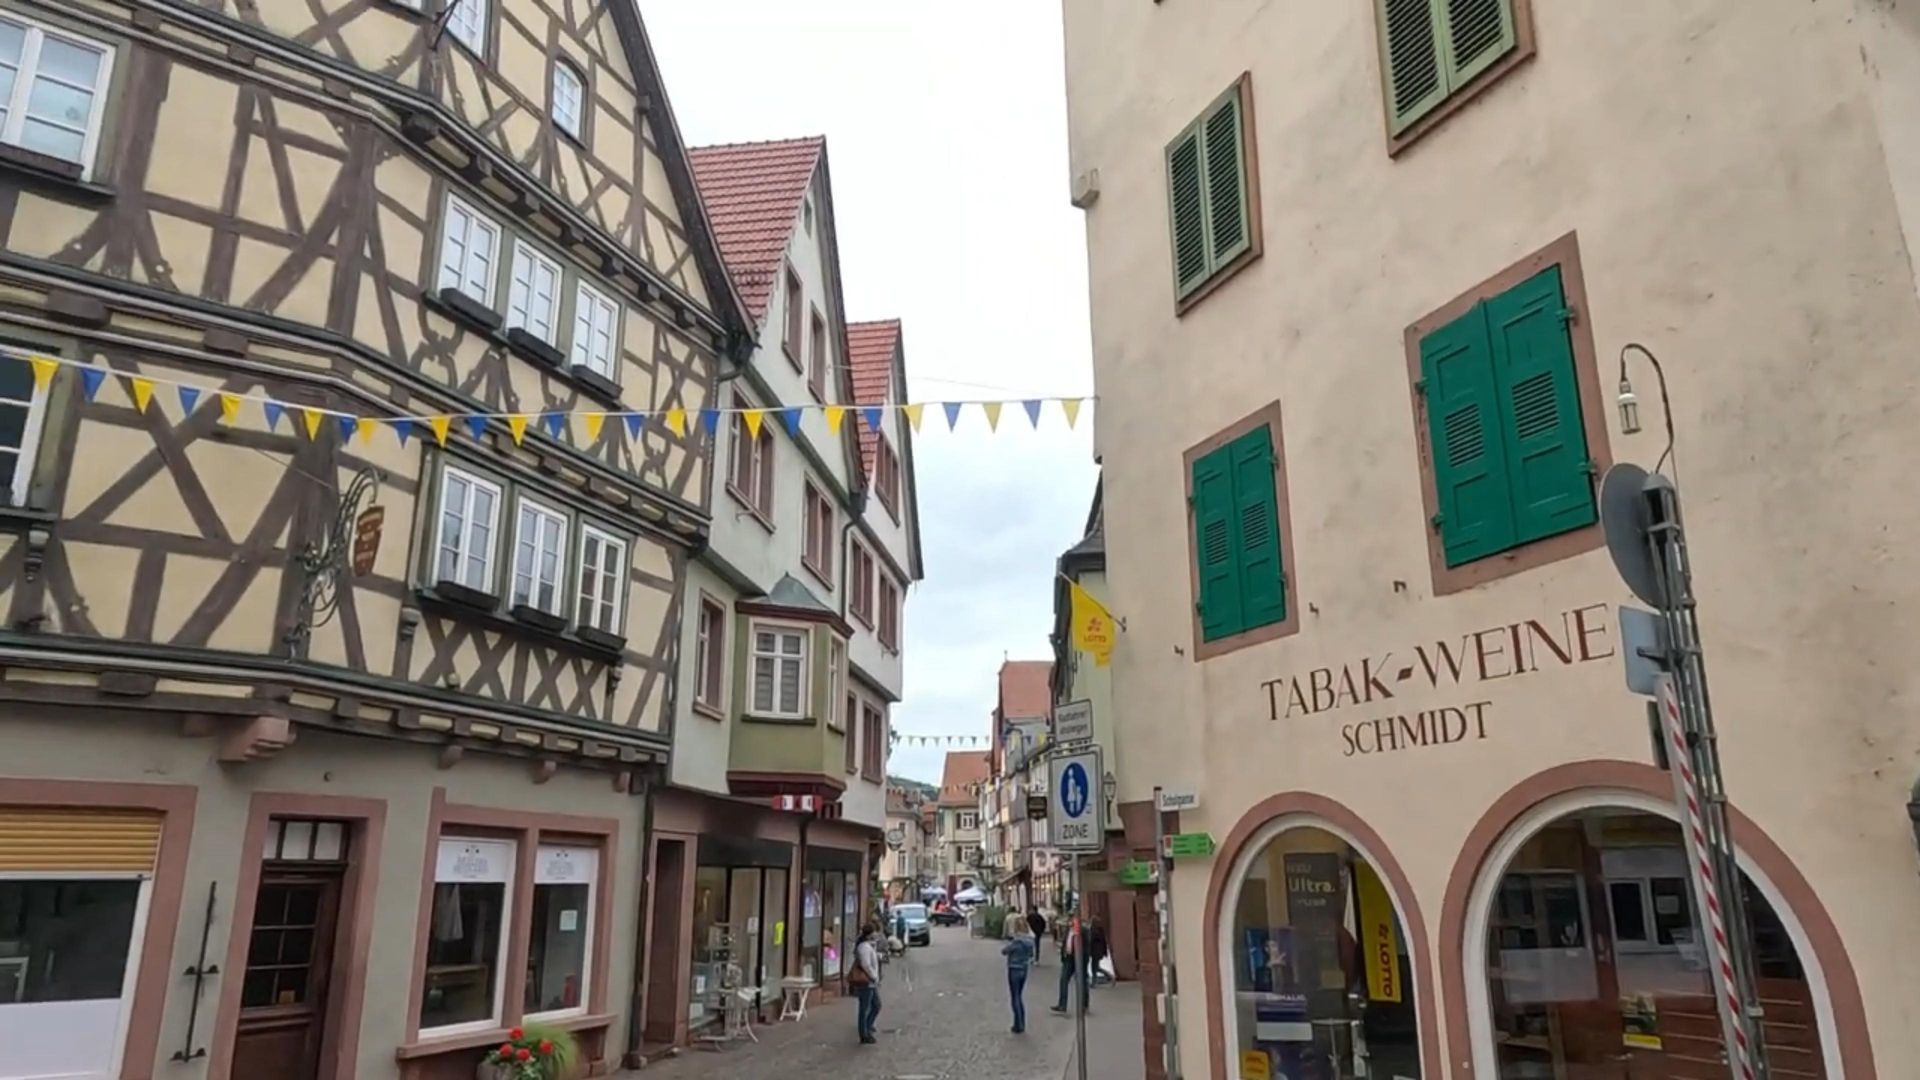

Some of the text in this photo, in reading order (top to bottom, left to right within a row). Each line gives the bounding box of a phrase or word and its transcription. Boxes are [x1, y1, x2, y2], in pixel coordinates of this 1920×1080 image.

[1261, 603, 1615, 721] TABAK-WEINE
[1342, 701, 1492, 757] SCHMIDT
[1062, 823, 1089, 840] ZONE
[1379, 943, 1393, 998] LOTTO
